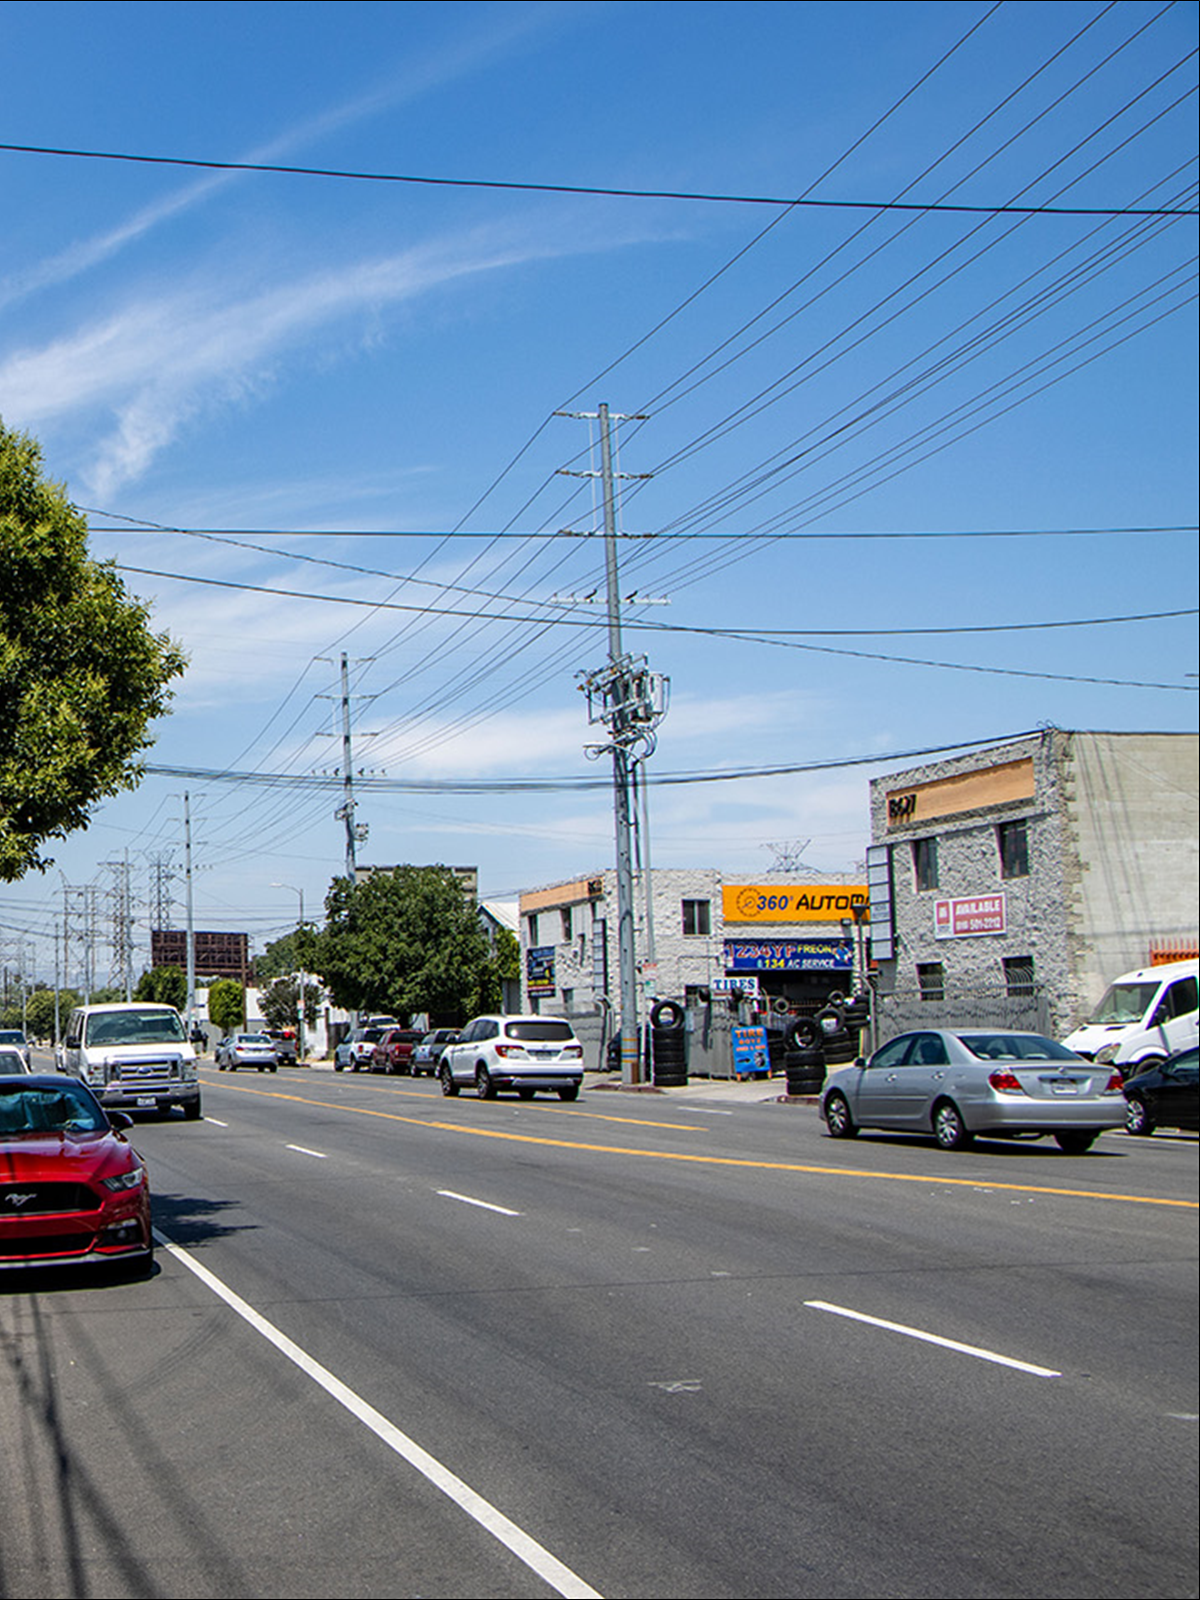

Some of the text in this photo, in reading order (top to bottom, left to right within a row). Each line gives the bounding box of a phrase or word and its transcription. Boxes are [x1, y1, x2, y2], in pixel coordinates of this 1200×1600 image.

[796, 893, 870, 911] AUTOM
[955, 899, 1001, 915] AVAILABLE
[797, 943, 831, 954] FREON
[764, 959, 785, 969] 134
[802, 958, 835, 968] SERVICE
[713, 978, 756, 990] TIRES
[734, 1027, 764, 1038] TIRE
